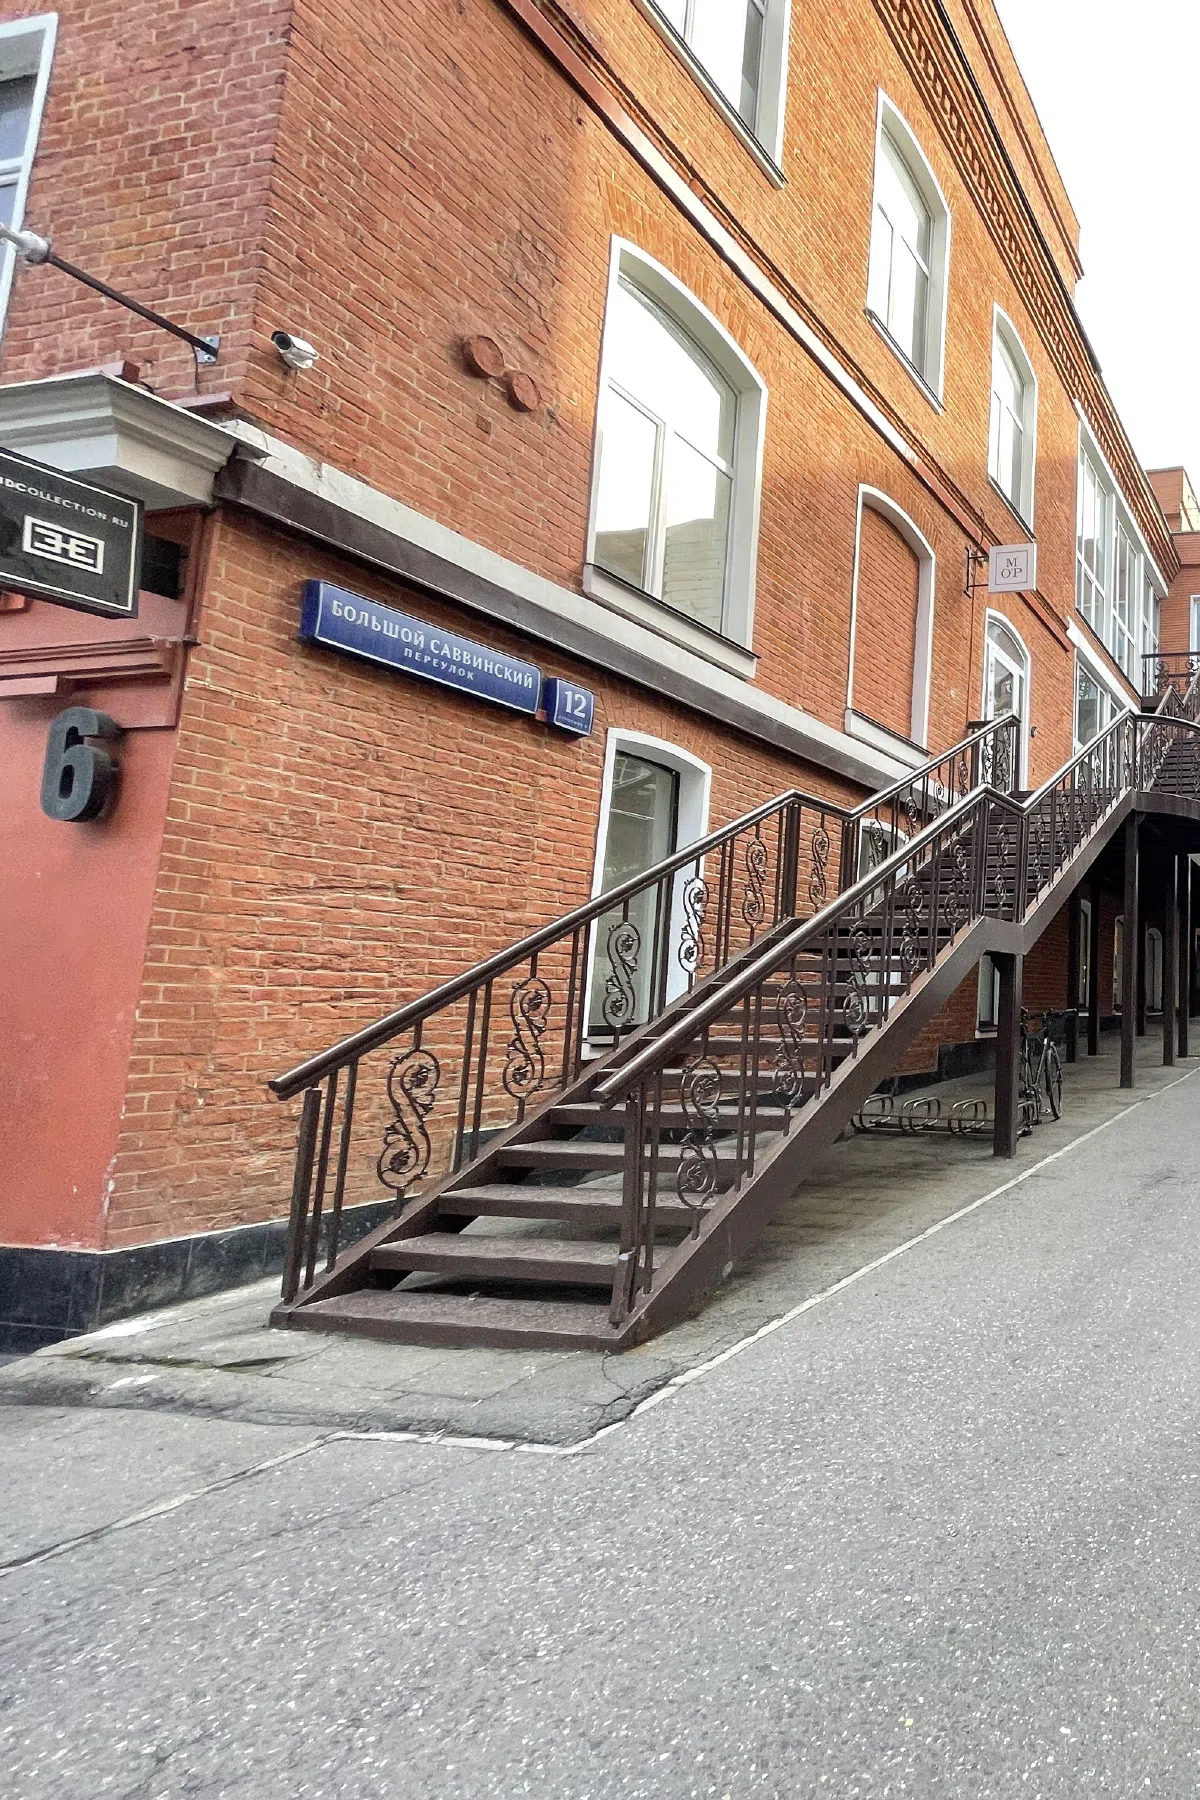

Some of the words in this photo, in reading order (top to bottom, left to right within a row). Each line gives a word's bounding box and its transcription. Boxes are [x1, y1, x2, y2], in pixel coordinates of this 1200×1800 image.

[331, 599, 425, 649] БОЛЬШОЙ
[429, 639, 533, 690] САВВИНСКИЙ
[403, 648, 475, 681] ПЕРЕУЛОК
[564, 690, 587, 719] 12
[40, 706, 110, 822] 6
